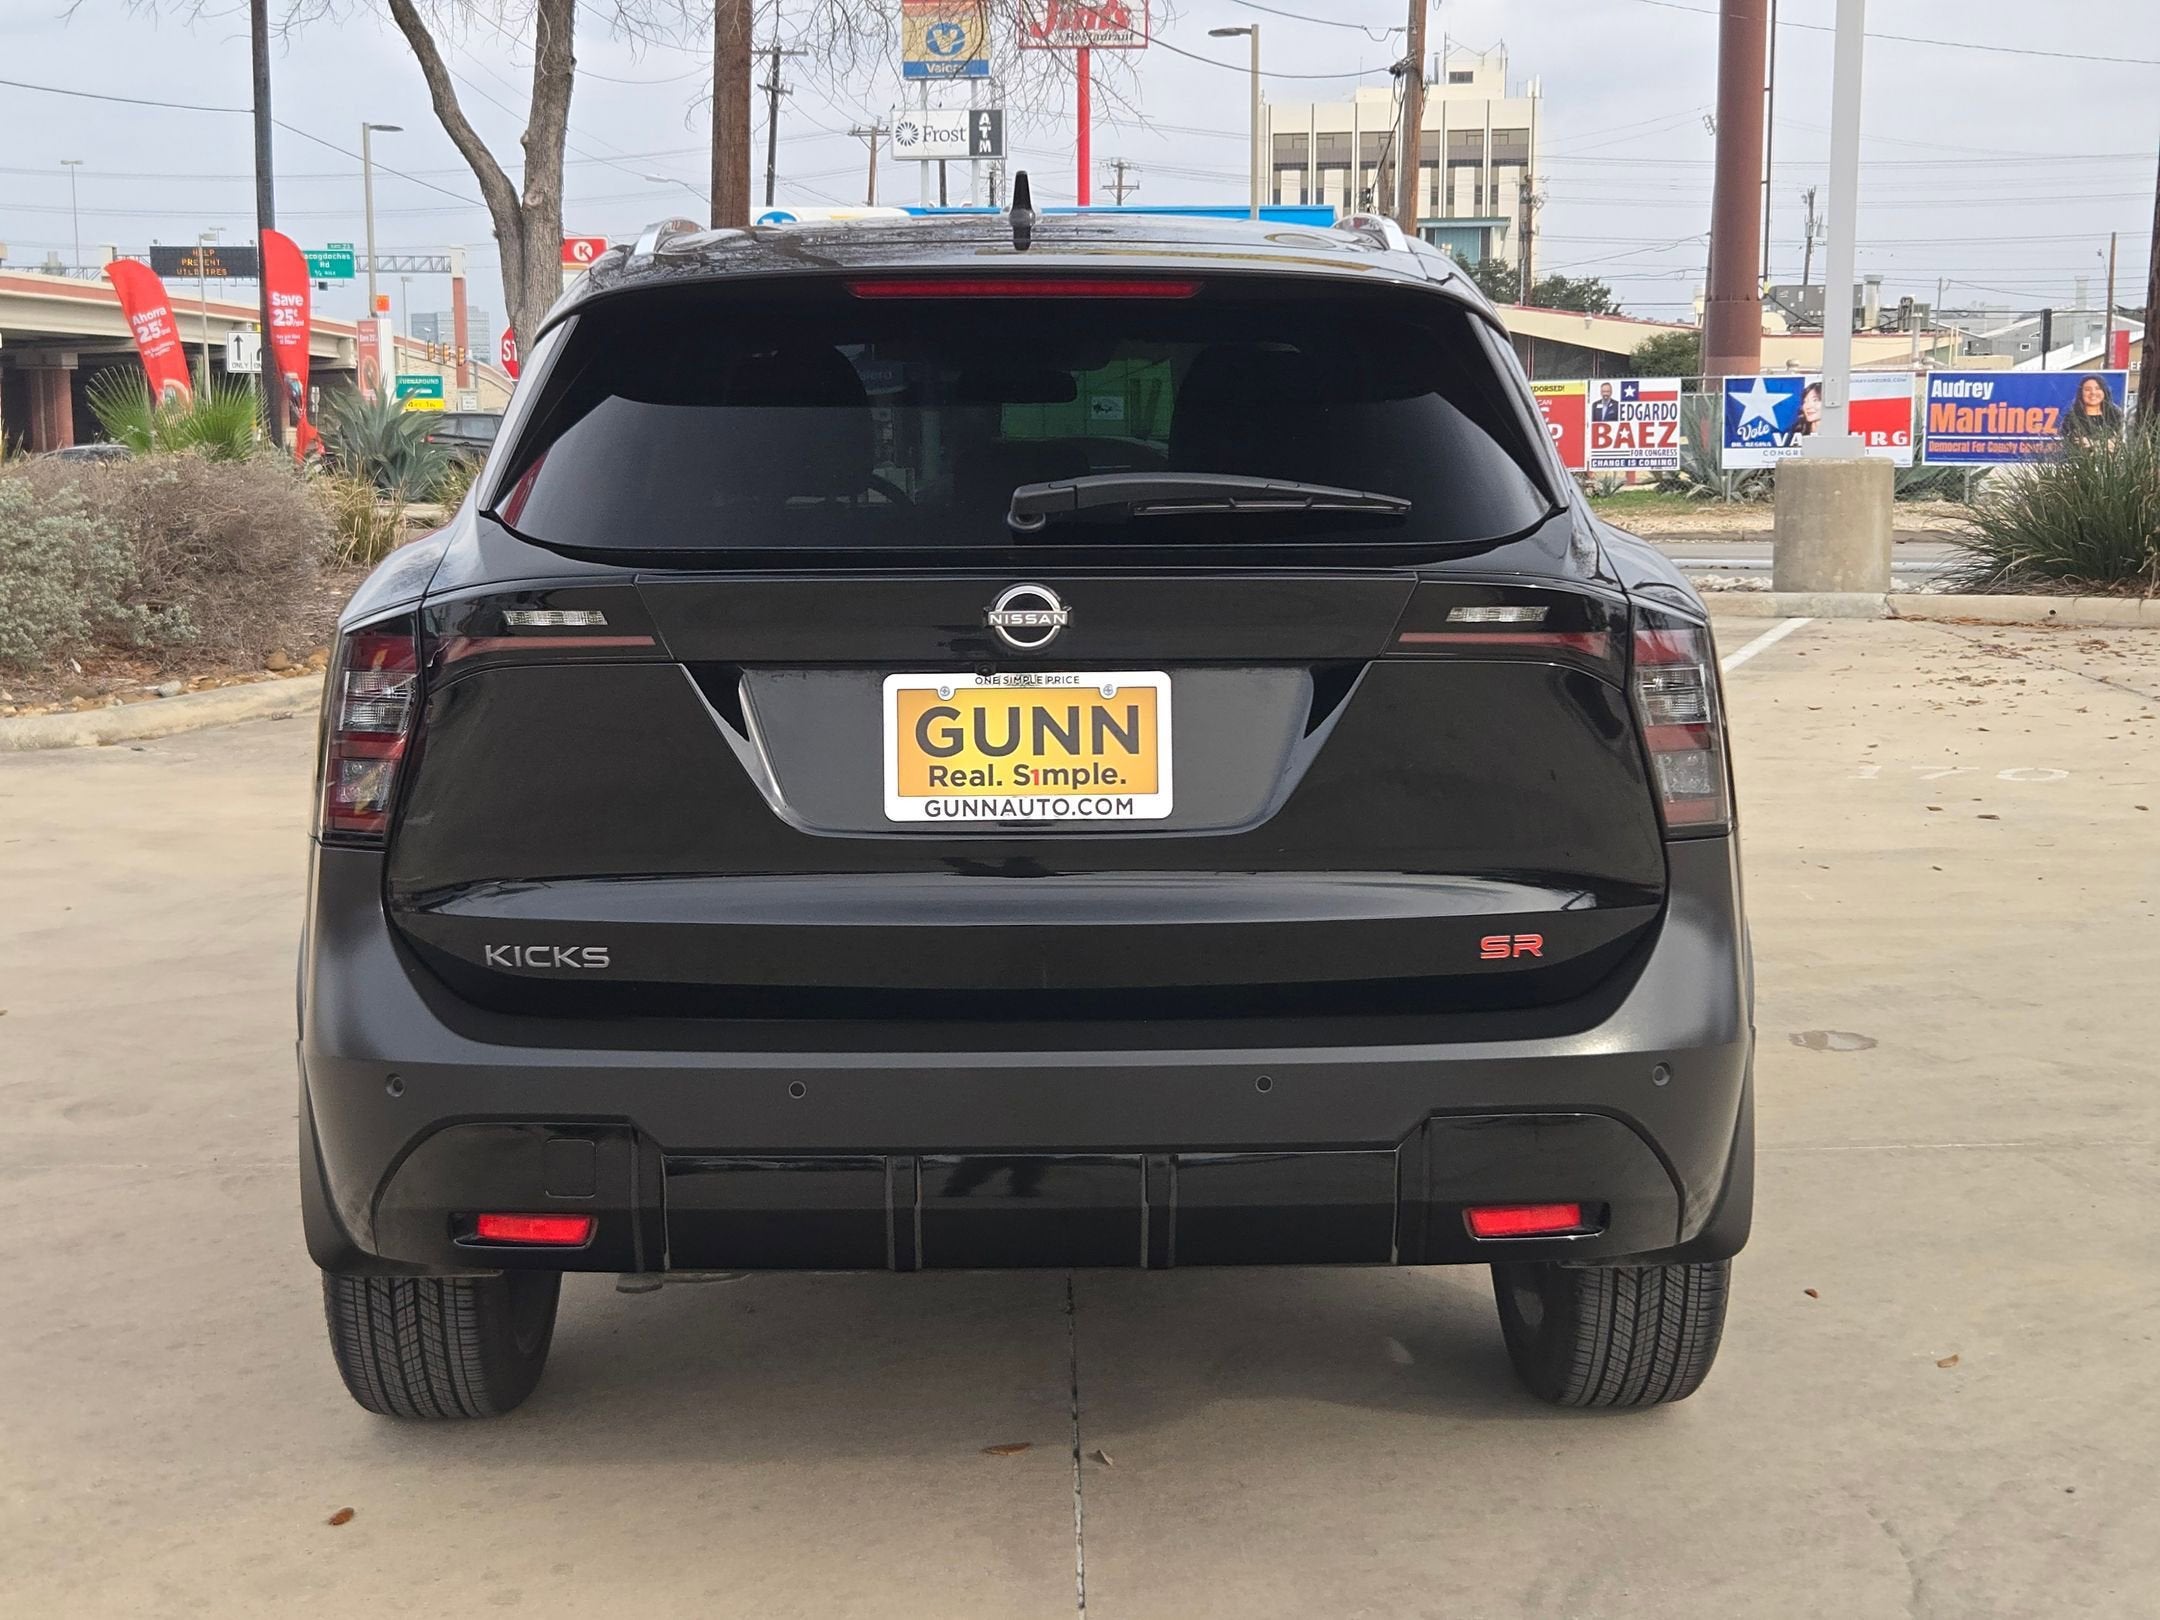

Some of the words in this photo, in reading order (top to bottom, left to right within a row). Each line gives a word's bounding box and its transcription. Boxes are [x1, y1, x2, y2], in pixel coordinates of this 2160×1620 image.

[922, 125, 967, 143] Frost
[979, 112, 992, 153] ATM
[192, 247, 216, 257] HLP
[181, 258, 220, 266] PREENT
[176, 268, 227, 276] WILDIRES
[272, 292, 304, 307] Save
[132, 306, 168, 326] Ahorra
[503, 340, 517, 361] ST
[1931, 379, 1994, 400] Audrey
[1620, 403, 1678, 421] EDGARDO
[1929, 402, 2060, 434] Martinez
[1591, 422, 1678, 449] BAEZ
[1737, 423, 1770, 441] Vote
[1762, 449, 1804, 457] CONGR
[1929, 440, 1970, 453] Democrat
[1971, 441, 1986, 453] For
[1638, 459, 1677, 467] COMING!
[989, 614, 1067, 625] NISSAN
[975, 676, 1000, 685] ONE
[1047, 675, 1080, 684] PRICE
[915, 705, 1140, 758] GUNN
[928, 763, 1003, 787] Real.
[924, 797, 1134, 818] GUNNAUTO.COM
[1480, 933, 1544, 960] SR
[484, 944, 611, 969] KICKS
